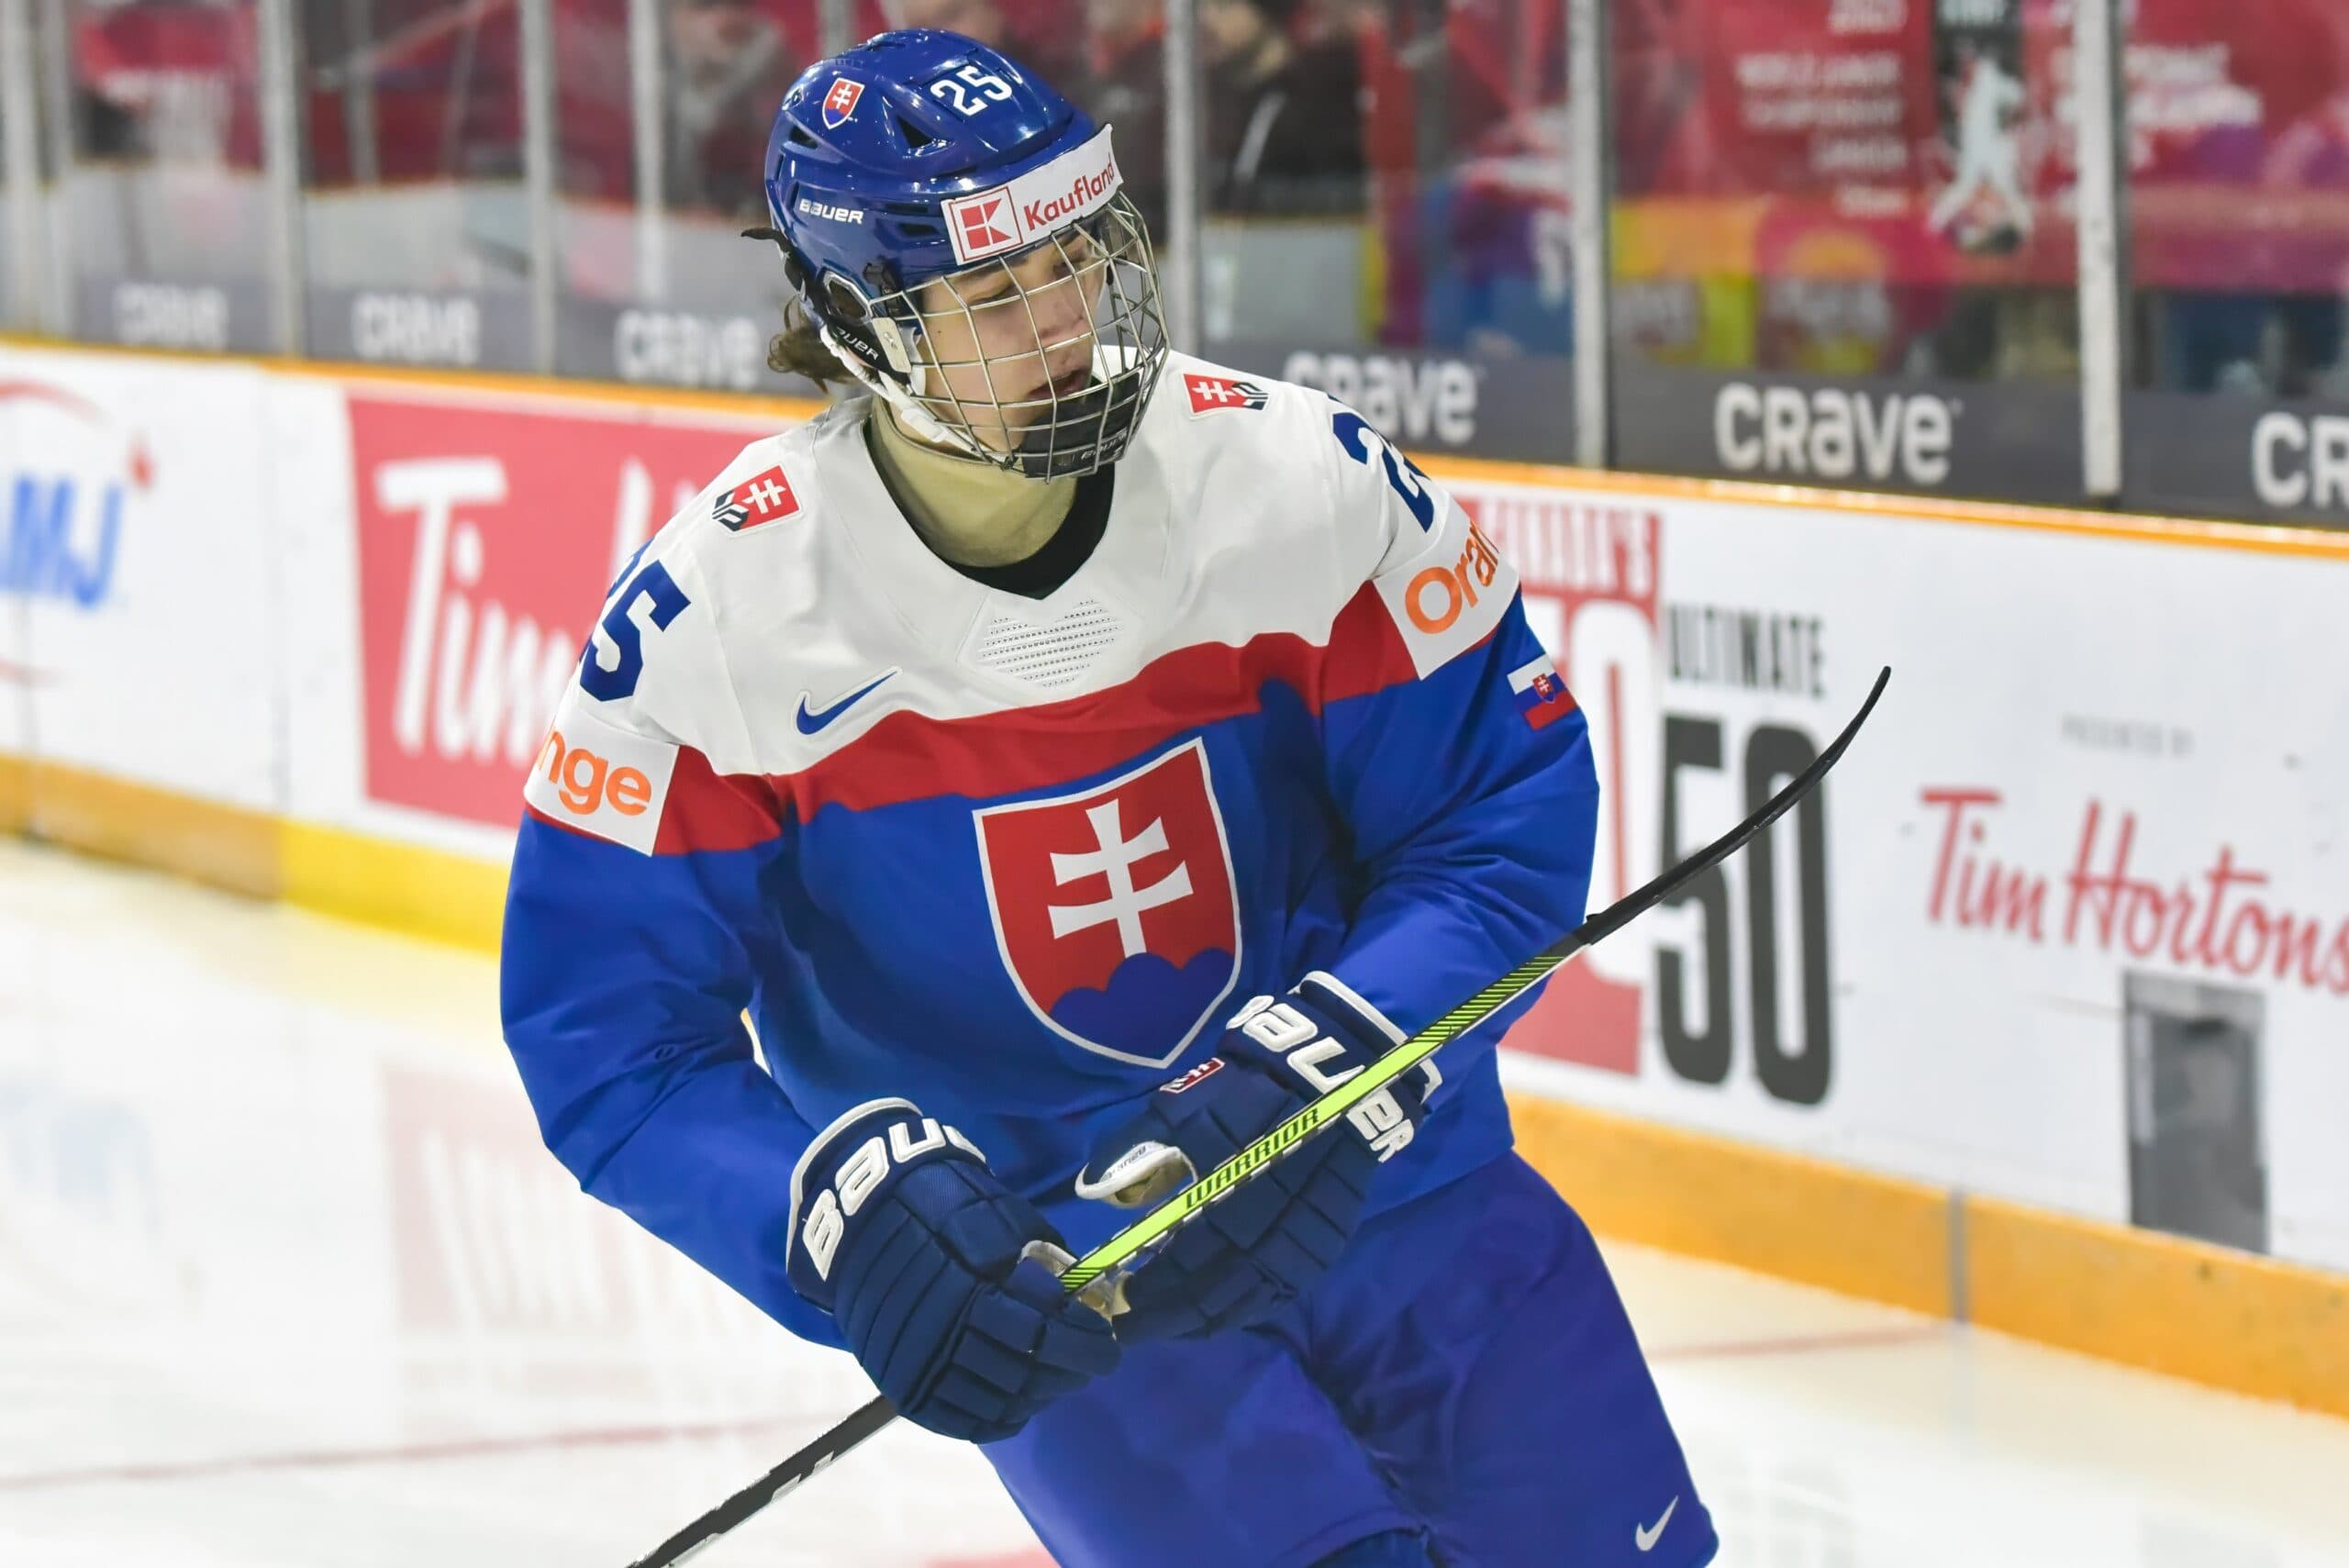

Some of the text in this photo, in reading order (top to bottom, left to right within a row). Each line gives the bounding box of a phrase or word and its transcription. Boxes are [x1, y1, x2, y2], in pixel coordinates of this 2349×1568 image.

[930, 65, 1013, 117] 25
[1023, 153, 1115, 231] Kaufland
[578, 536, 691, 702] 5
[1655, 713, 1833, 1107] 50
[1920, 785, 2349, 999] Tim Hortons
[1186, 1107, 1319, 1209] WARRIOR
